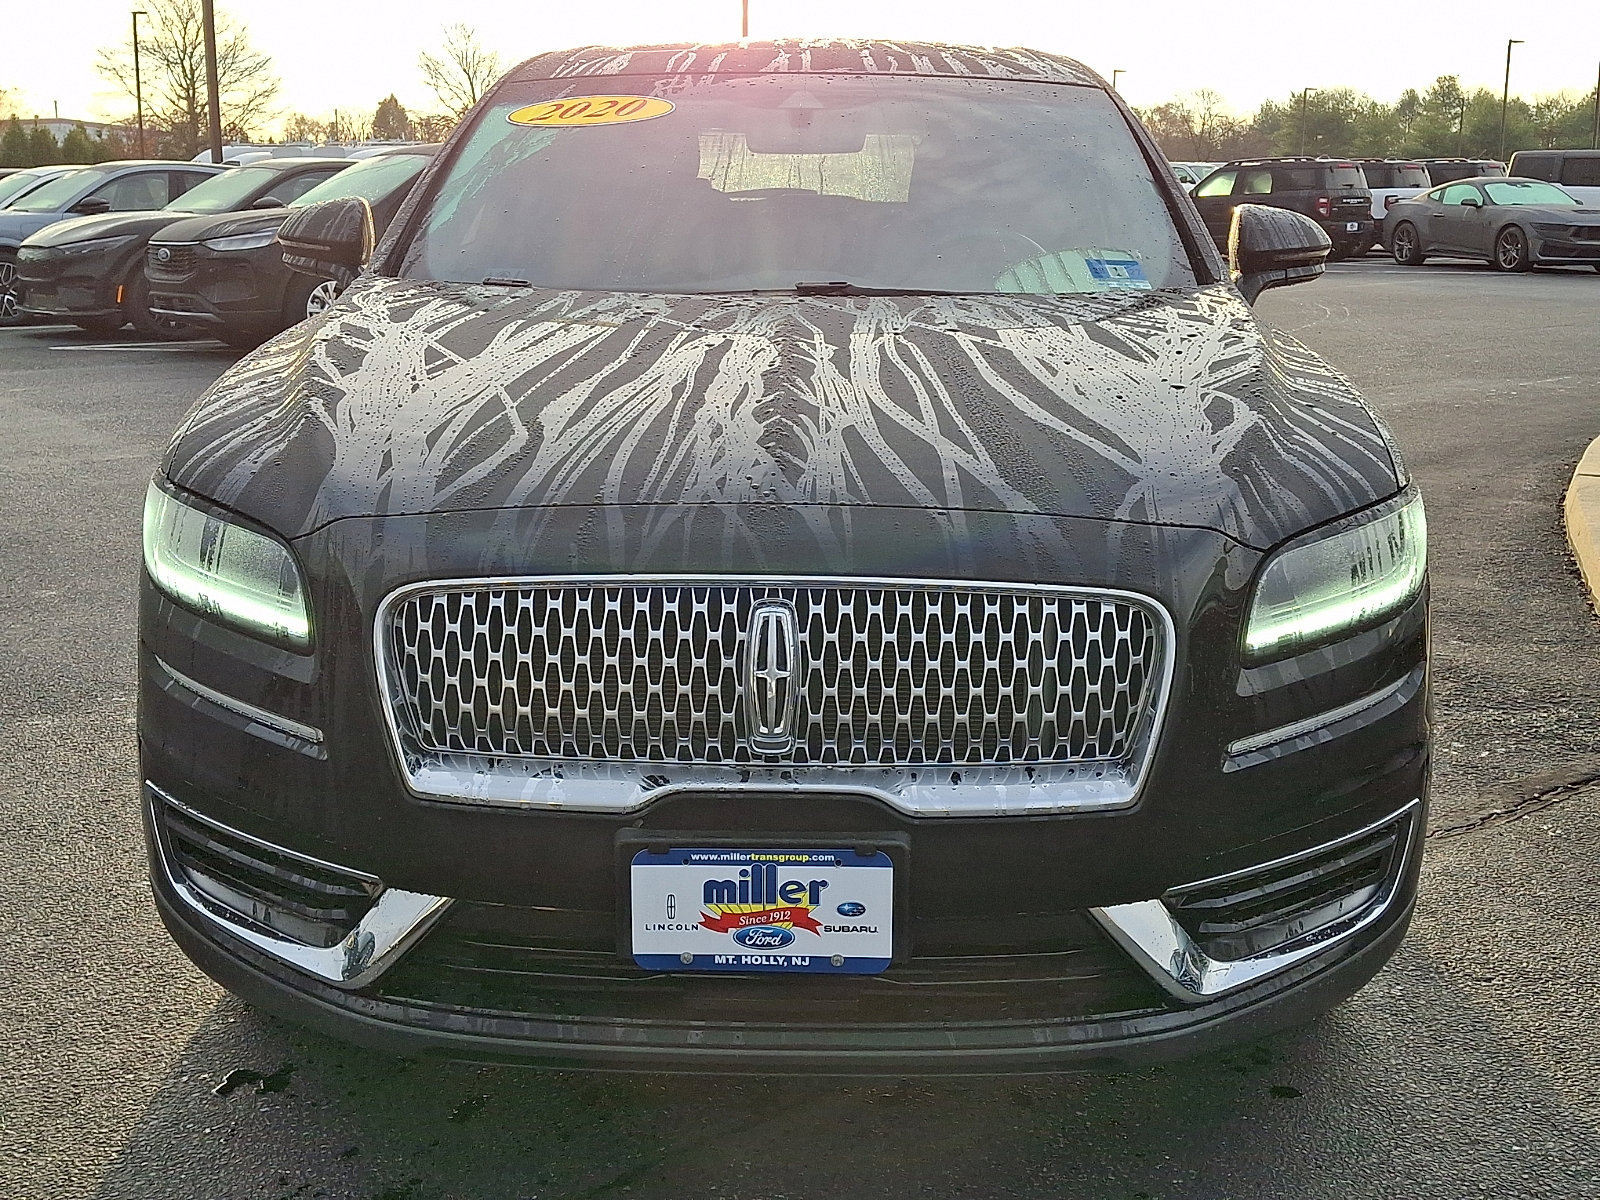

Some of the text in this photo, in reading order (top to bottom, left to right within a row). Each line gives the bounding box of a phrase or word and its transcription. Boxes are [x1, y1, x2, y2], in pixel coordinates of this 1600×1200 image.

[527, 99, 648, 121] 2020
[691, 852, 835, 863] www.millertransgroup.com
[703, 863, 829, 905] miller
[739, 911, 791, 926] Since 1912
[645, 923, 699, 931] LINCOLN
[745, 928, 782, 945] Ford
[714, 955, 810, 967] MT. HOLLY, NJ
